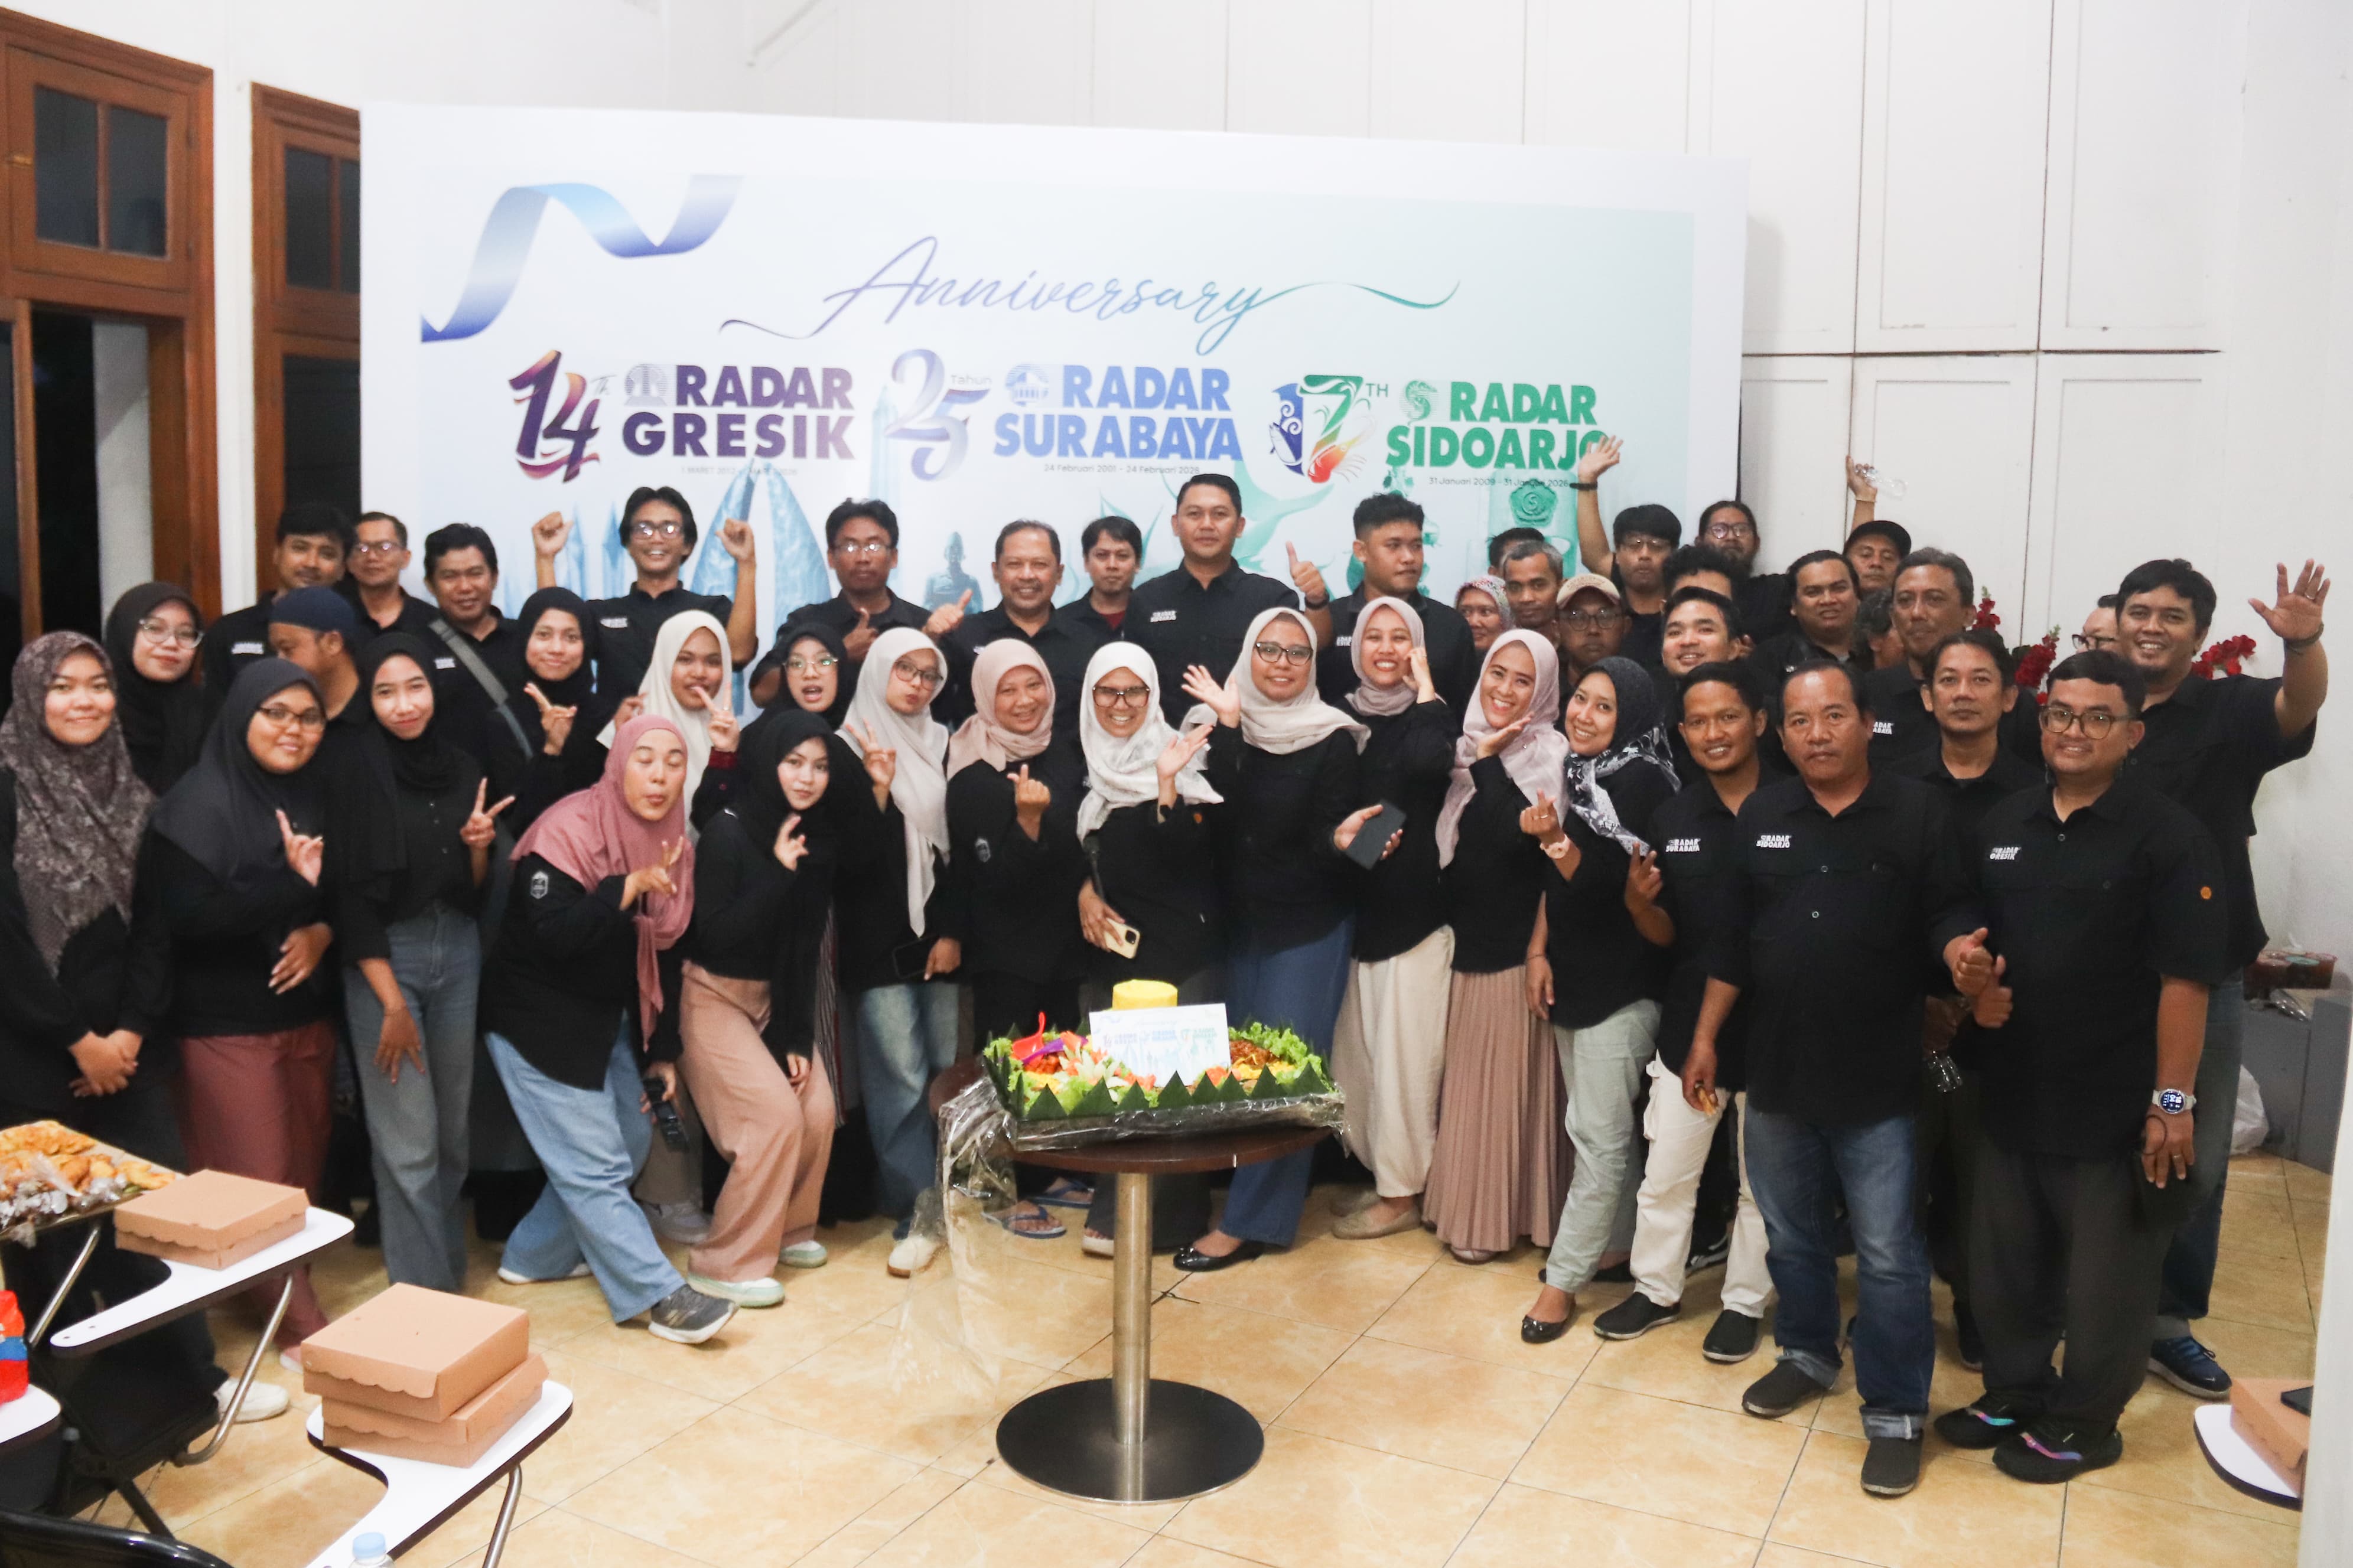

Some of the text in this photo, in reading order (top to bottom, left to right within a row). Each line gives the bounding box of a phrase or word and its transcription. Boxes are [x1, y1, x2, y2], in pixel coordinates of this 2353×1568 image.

[720, 235, 1459, 356] Anniversary
[676, 364, 855, 410] RADAR
[1063, 364, 1232, 411] RADAR
[1366, 383, 1388, 397] TH
[1450, 381, 1598, 425] RADAR
[508, 349, 601, 484] 14
[622, 412, 855, 459] GRESIK
[886, 348, 993, 481] 25 Tahun
[994, 413, 1245, 462] SURABAYA
[1057, 464, 1094, 472] Februari
[1756, 840, 1790, 849] SIDOARJO
